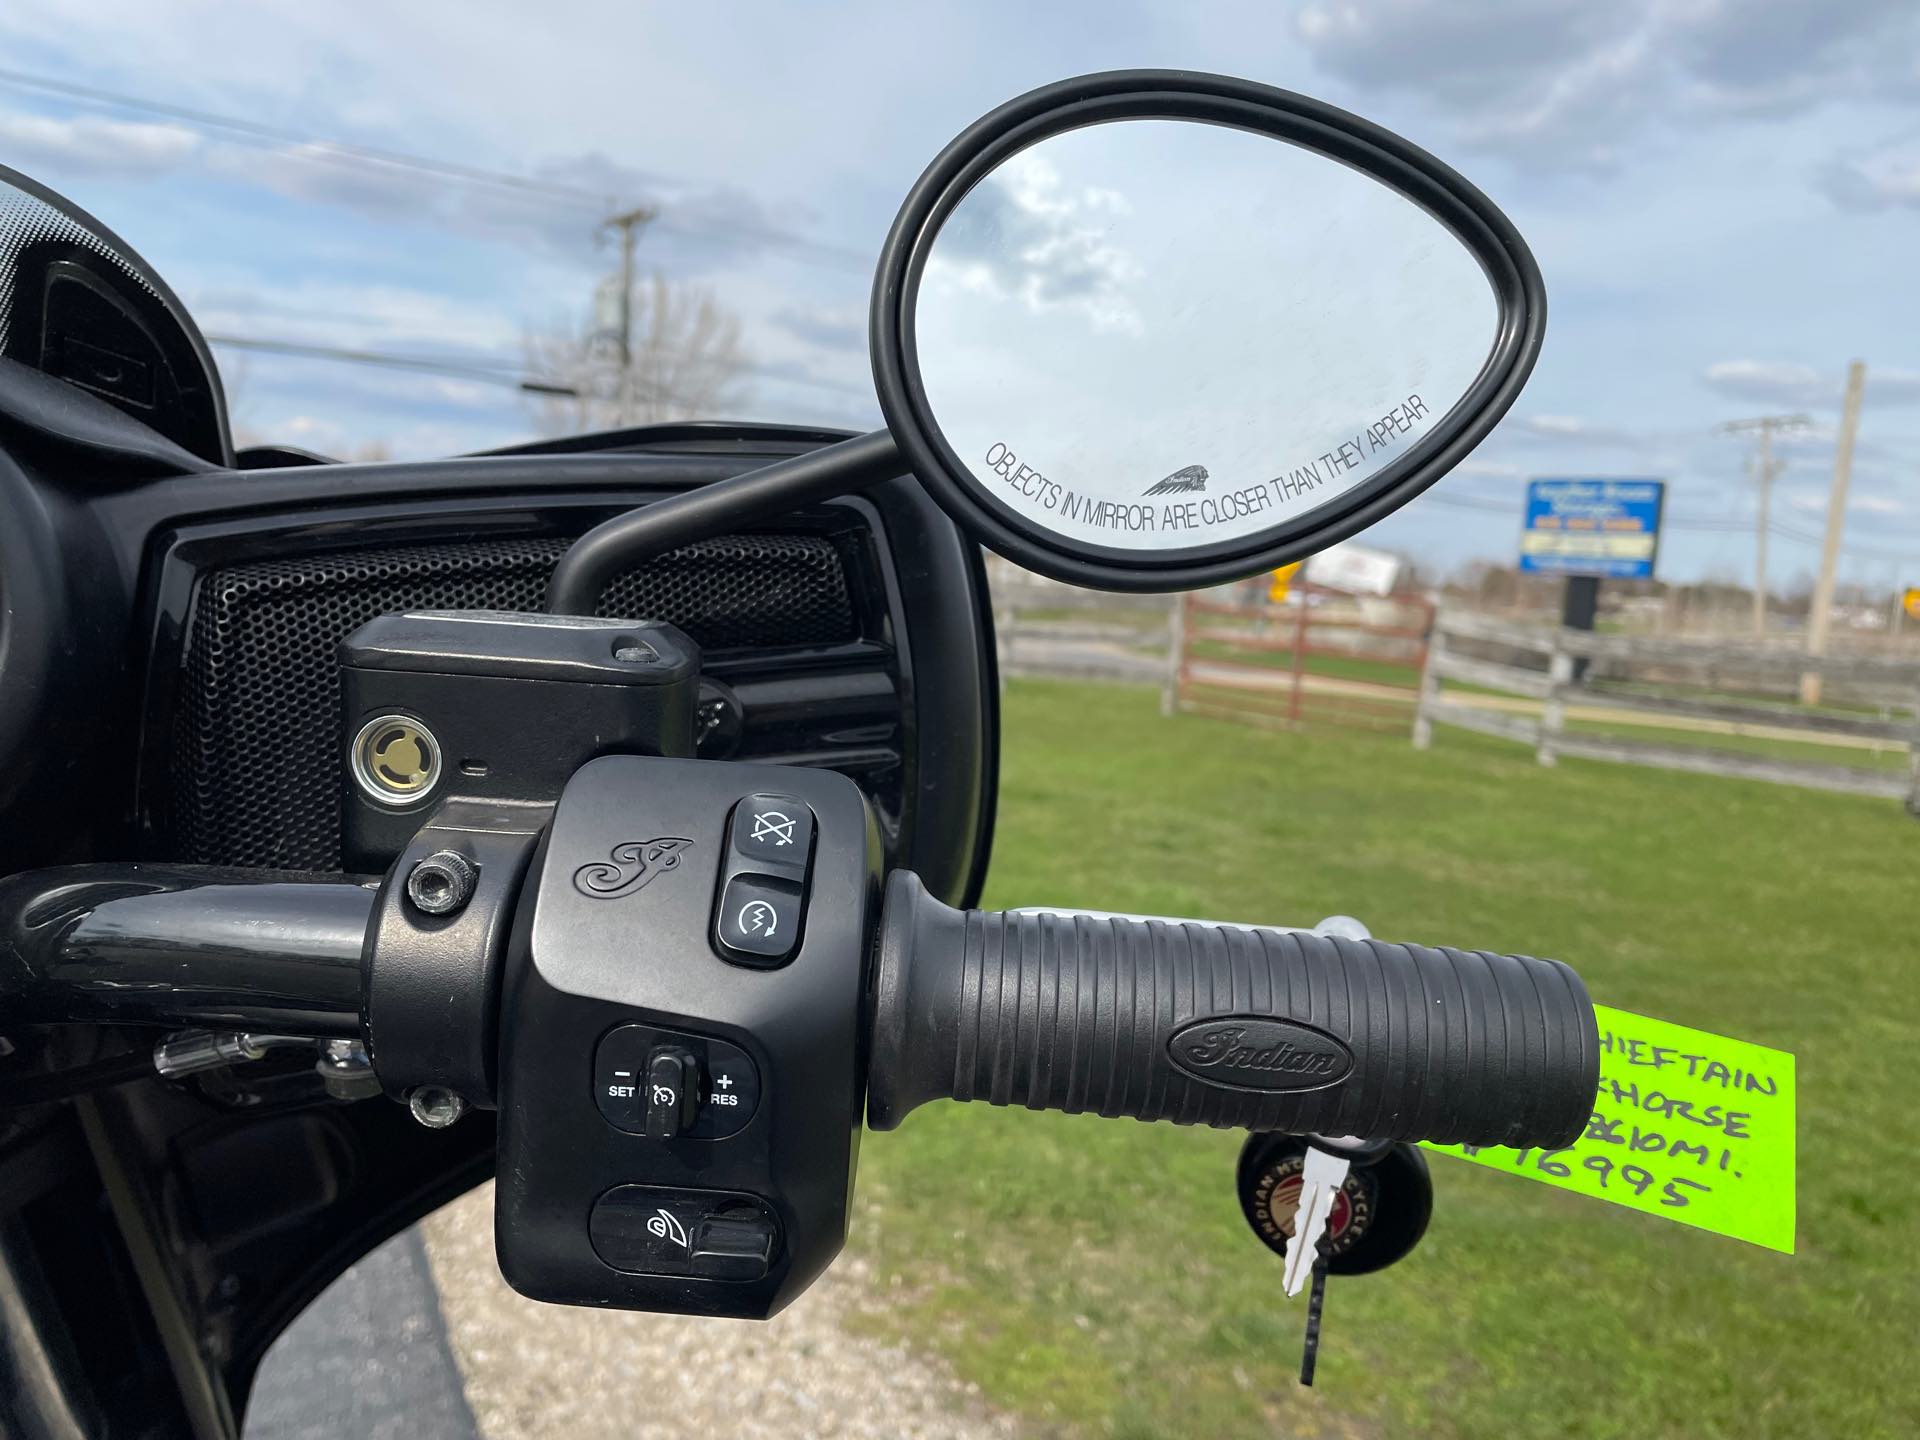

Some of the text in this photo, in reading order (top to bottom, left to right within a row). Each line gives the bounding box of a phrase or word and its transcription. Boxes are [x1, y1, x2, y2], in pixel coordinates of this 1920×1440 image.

[985, 394, 1429, 531] OBJECTS IN MIRROR ARE CLOSER THAN THEY APPEAR
[1187, 1028, 1337, 1075] Indian
[608, 1085, 635, 1097] SET
[710, 1093, 738, 1106] RES
[1598, 1076, 1751, 1139] HORSE
